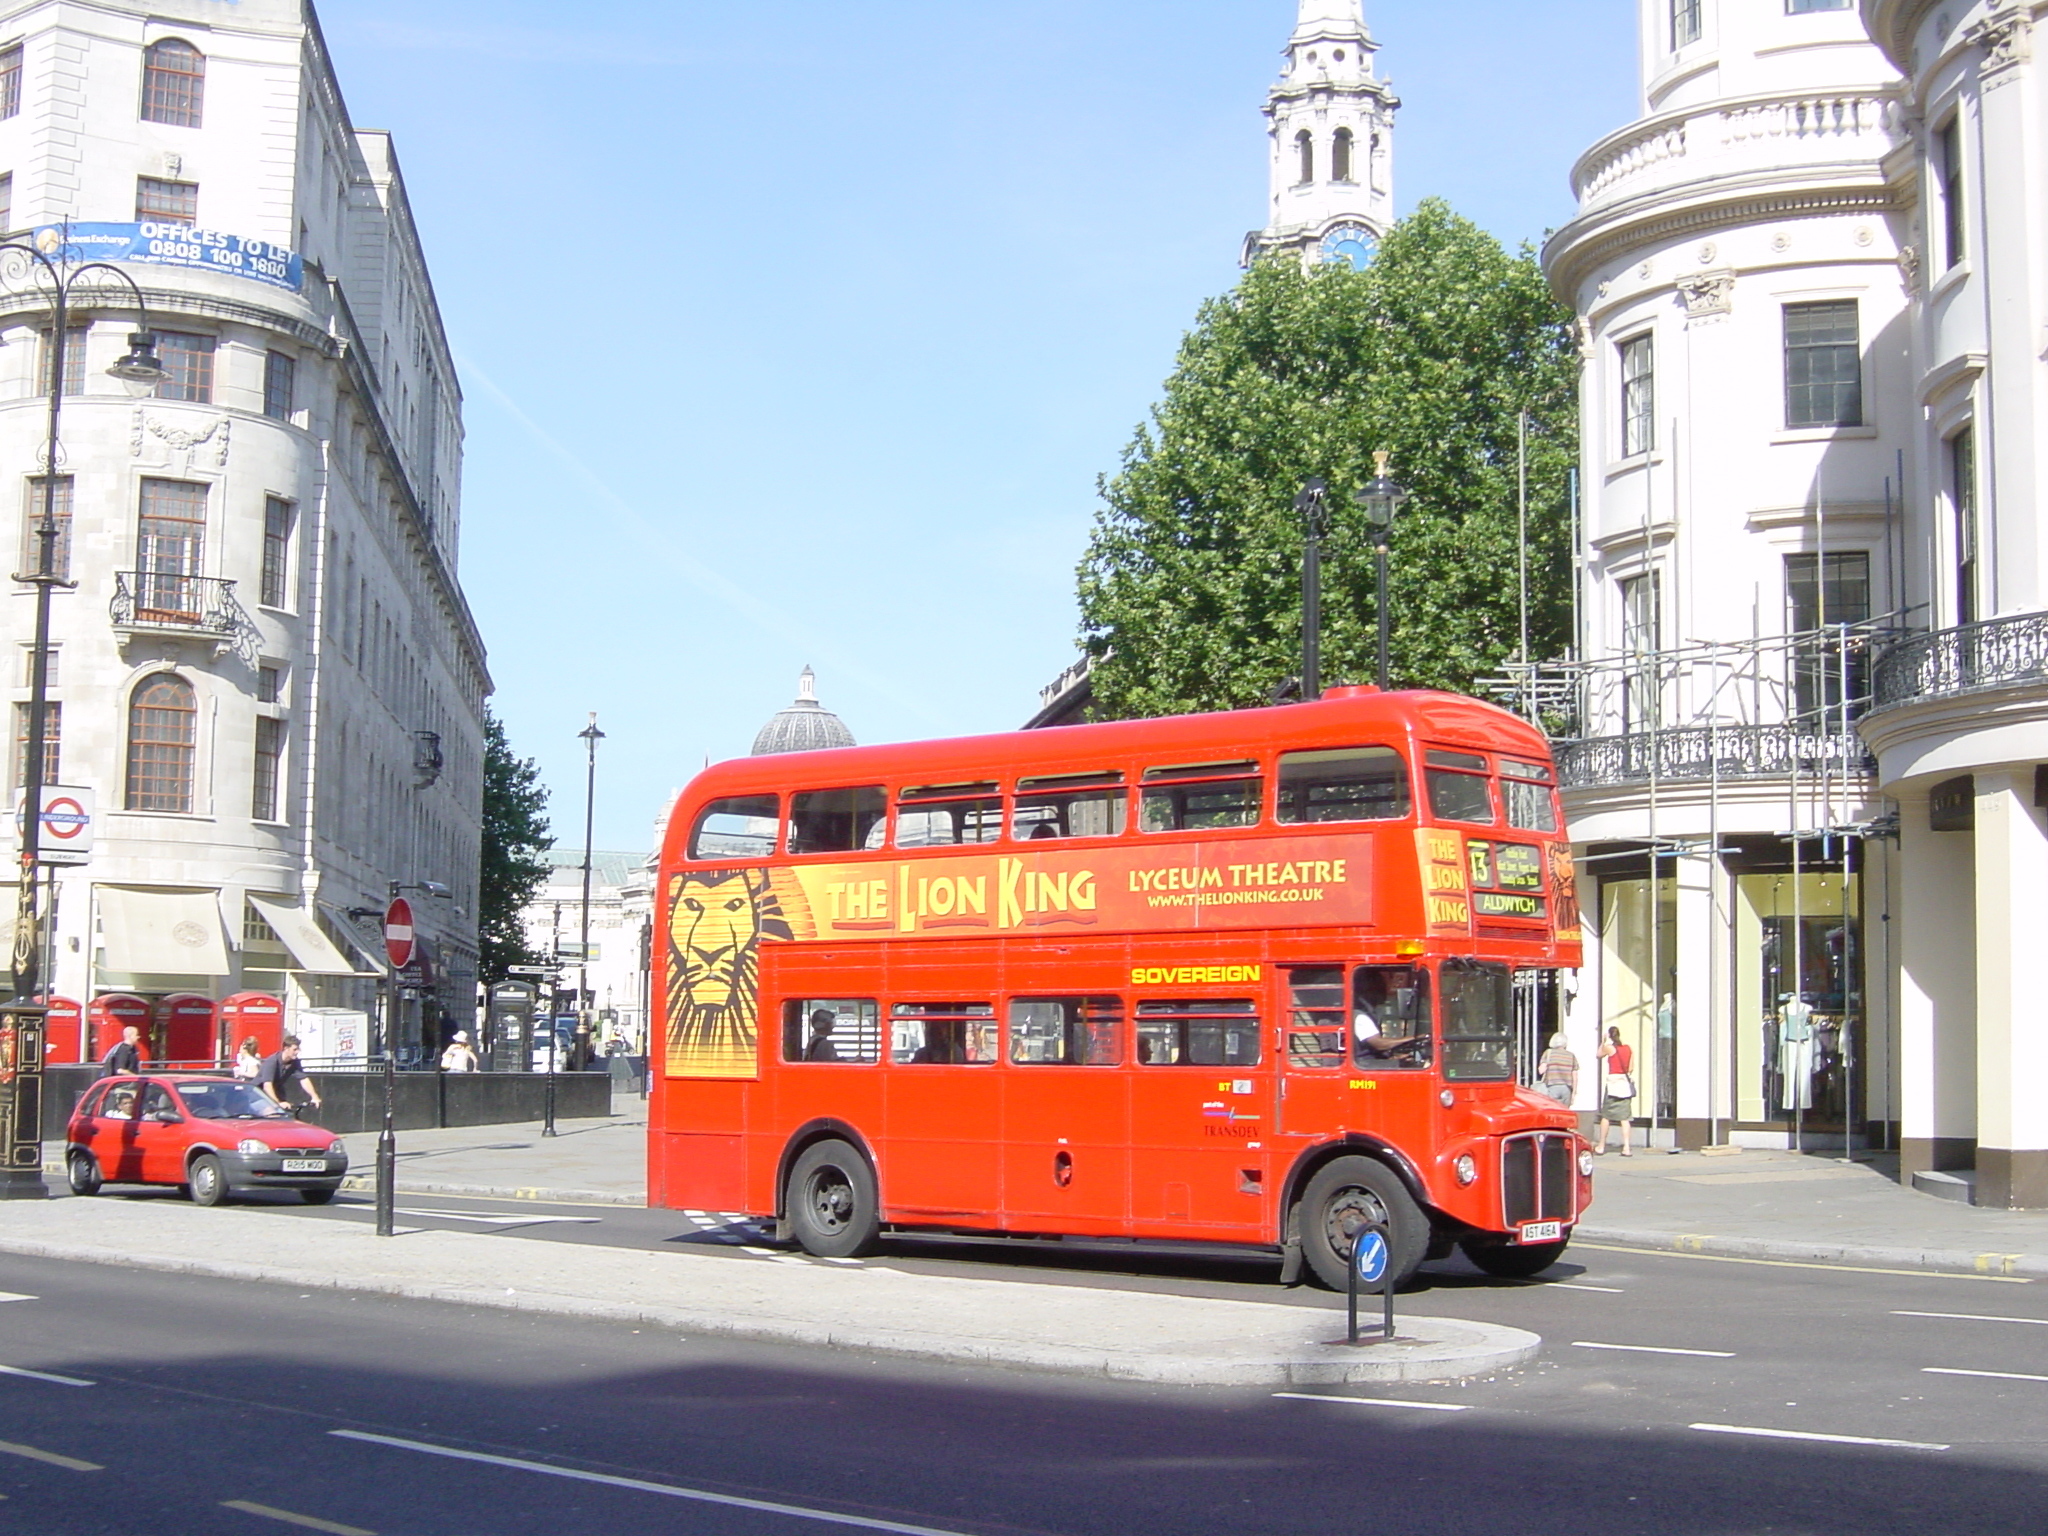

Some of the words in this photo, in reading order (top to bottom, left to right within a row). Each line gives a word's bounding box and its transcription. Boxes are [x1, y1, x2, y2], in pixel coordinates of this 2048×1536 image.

[140, 222, 228, 248] OFFICES
[236, 235, 262, 255] TO
[267, 244, 295, 264] LET
[149, 240, 202, 259] 0808
[209, 248, 243, 266] 100
[1428, 838, 1456, 860] THE
[1129, 866, 1223, 892] LYCEUM
[1228, 859, 1346, 887] THEATRE
[1424, 865, 1465, 890] LION
[1470, 851, 1488, 882] 13
[826, 879, 888, 920] THE
[900, 865, 986, 933] LION
[998, 857, 1096, 928] KING
[1147, 888, 1324, 907] WWW.THELIONKING.CO.UK
[1483, 896, 1535, 913] ALDWYCH
[1428, 897, 1468, 923] KING
[1131, 965, 1261, 984] SOVEREIGN
[1218, 1082, 1232, 1092] BT
[1349, 1079, 1376, 1090] RM191
[1204, 1125, 1260, 1138] TRANSDEV
[1525, 1225, 1539, 1239] AST
